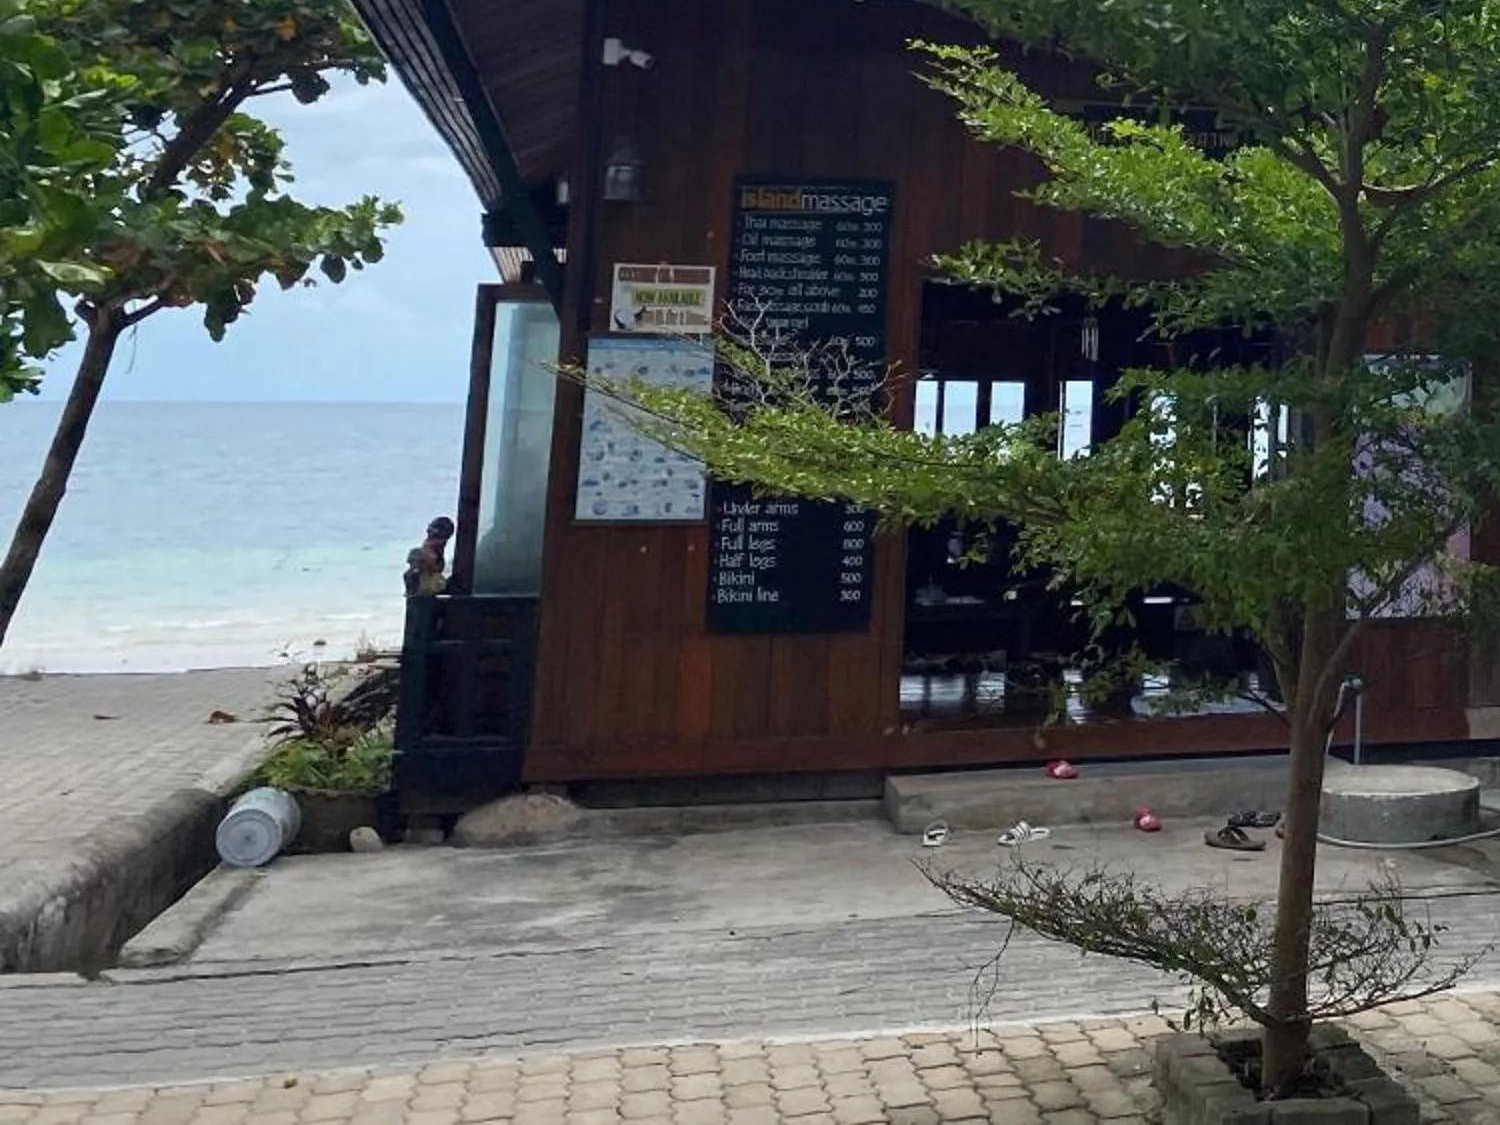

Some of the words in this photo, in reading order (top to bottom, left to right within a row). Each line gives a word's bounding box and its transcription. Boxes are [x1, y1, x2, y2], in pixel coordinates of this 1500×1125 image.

[741, 232, 758, 246] Oil
[723, 501, 760, 515] Under
[764, 503, 799, 515] arms
[721, 517, 746, 533] Full
[749, 521, 779, 533] arms
[720, 534, 744, 550] Full
[748, 535, 777, 552] legs
[719, 553, 745, 568] Half
[748, 553, 777, 570] legs
[841, 555, 863, 567] 400
[718, 570, 755, 585] Bikini
[717, 588, 753, 603] Bikini
[756, 588, 780, 603] line
